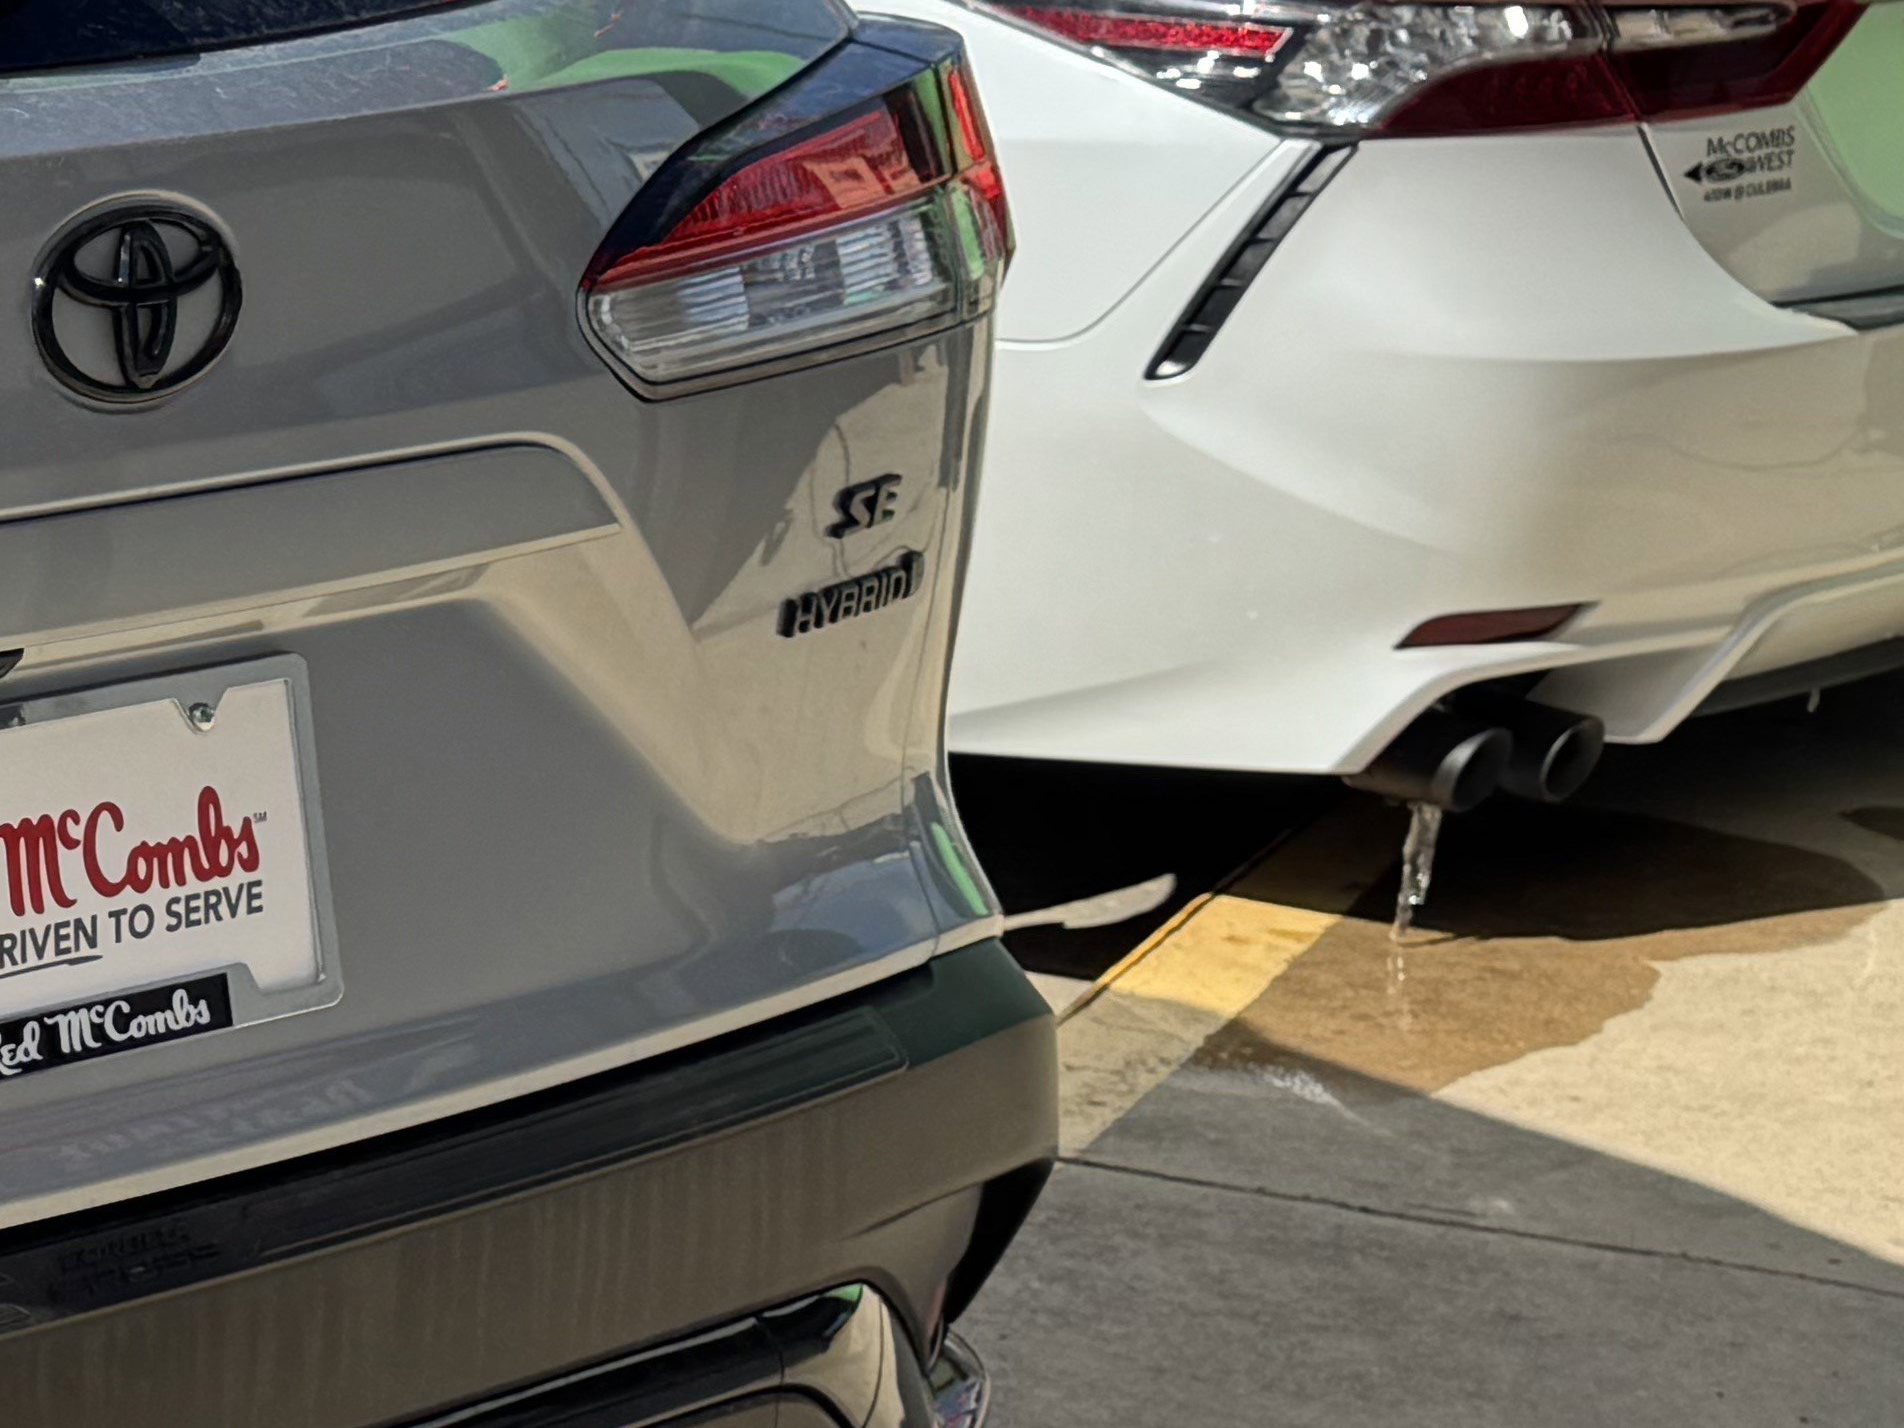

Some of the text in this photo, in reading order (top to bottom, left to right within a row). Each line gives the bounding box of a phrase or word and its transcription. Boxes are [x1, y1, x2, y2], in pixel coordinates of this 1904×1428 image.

[1706, 124, 1796, 157] McCOMBS
[824, 472, 903, 540] SE
[775, 549, 925, 639] HYBRID
[110, 903, 155, 944] TO
[164, 879, 264, 933] SERVE
[43, 988, 211, 1055] McCombs
